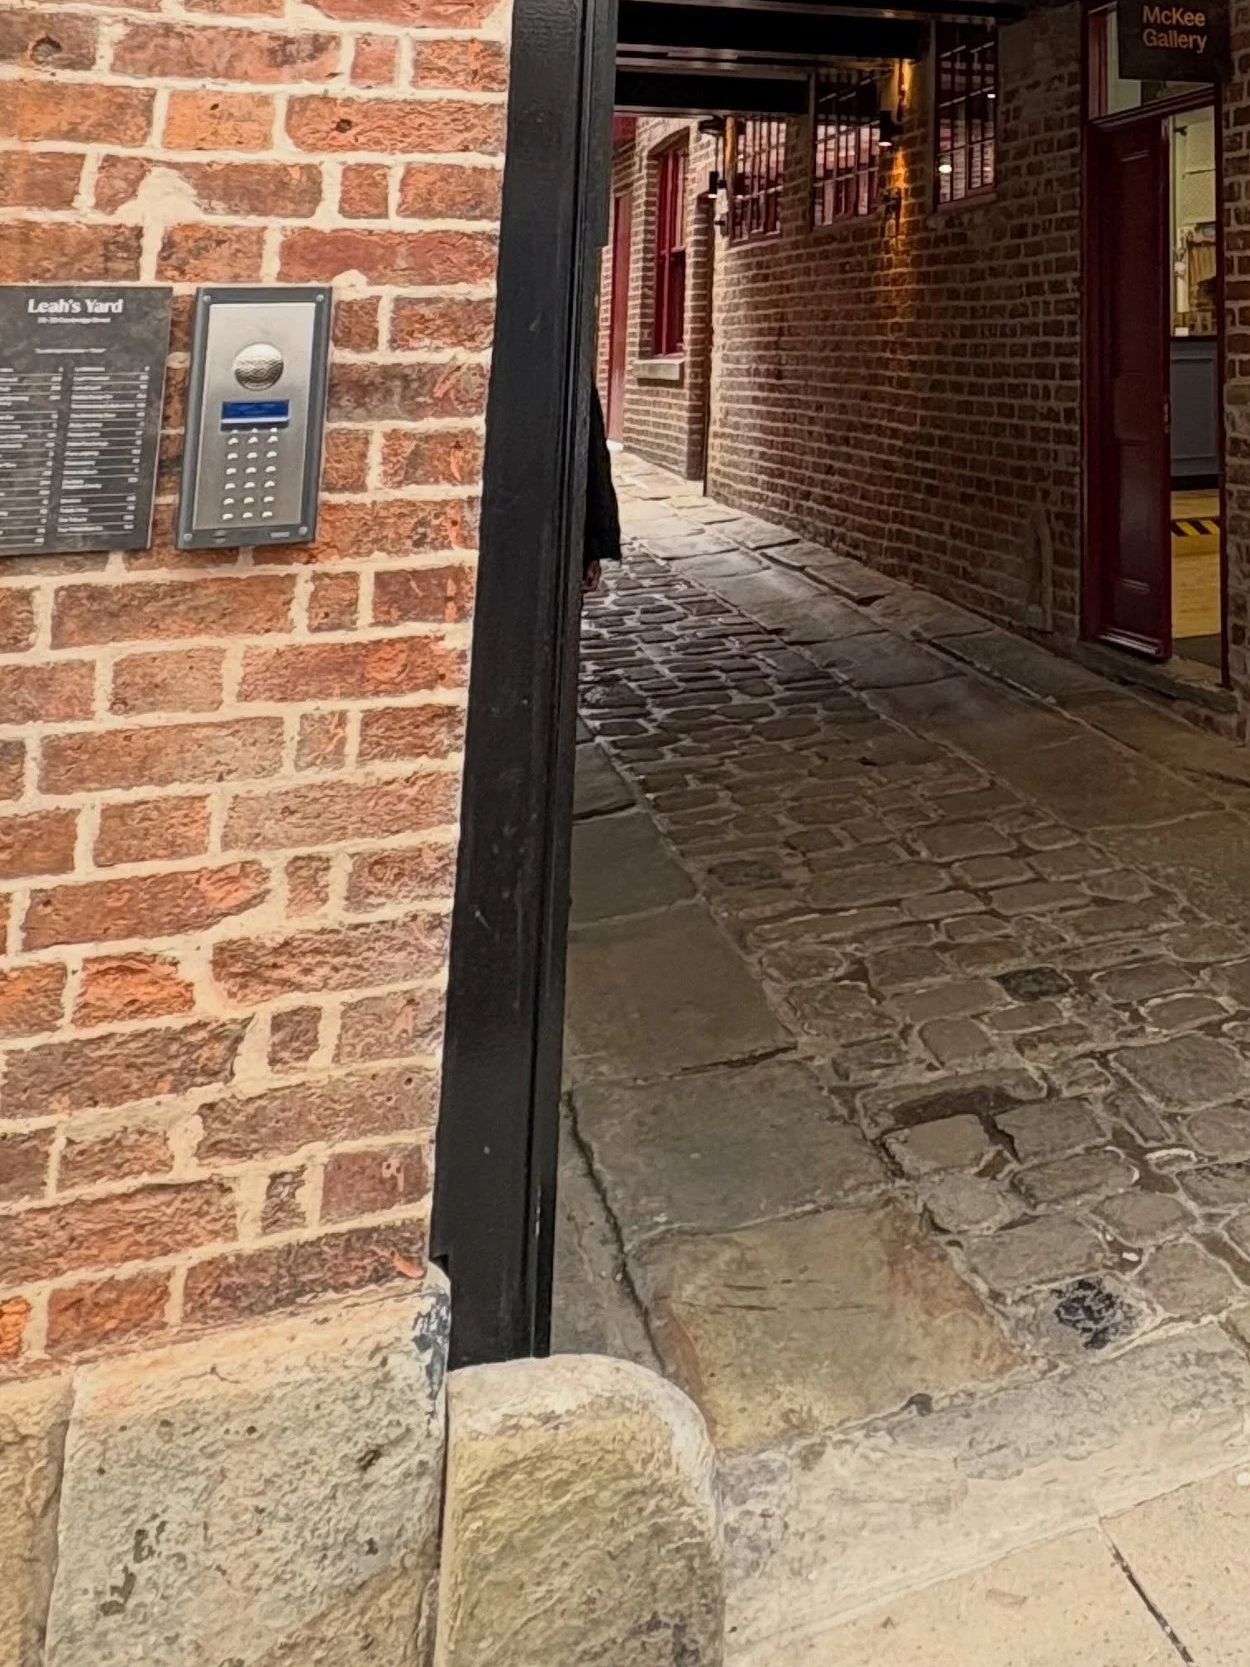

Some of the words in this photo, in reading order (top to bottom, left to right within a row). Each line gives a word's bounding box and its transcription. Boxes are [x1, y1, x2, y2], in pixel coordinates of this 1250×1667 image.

[1142, 5, 1206, 27] McKee
[1142, 28, 1208, 54] Gallery
[28, 298, 81, 314] Leah's
[85, 298, 124, 314] Yard
